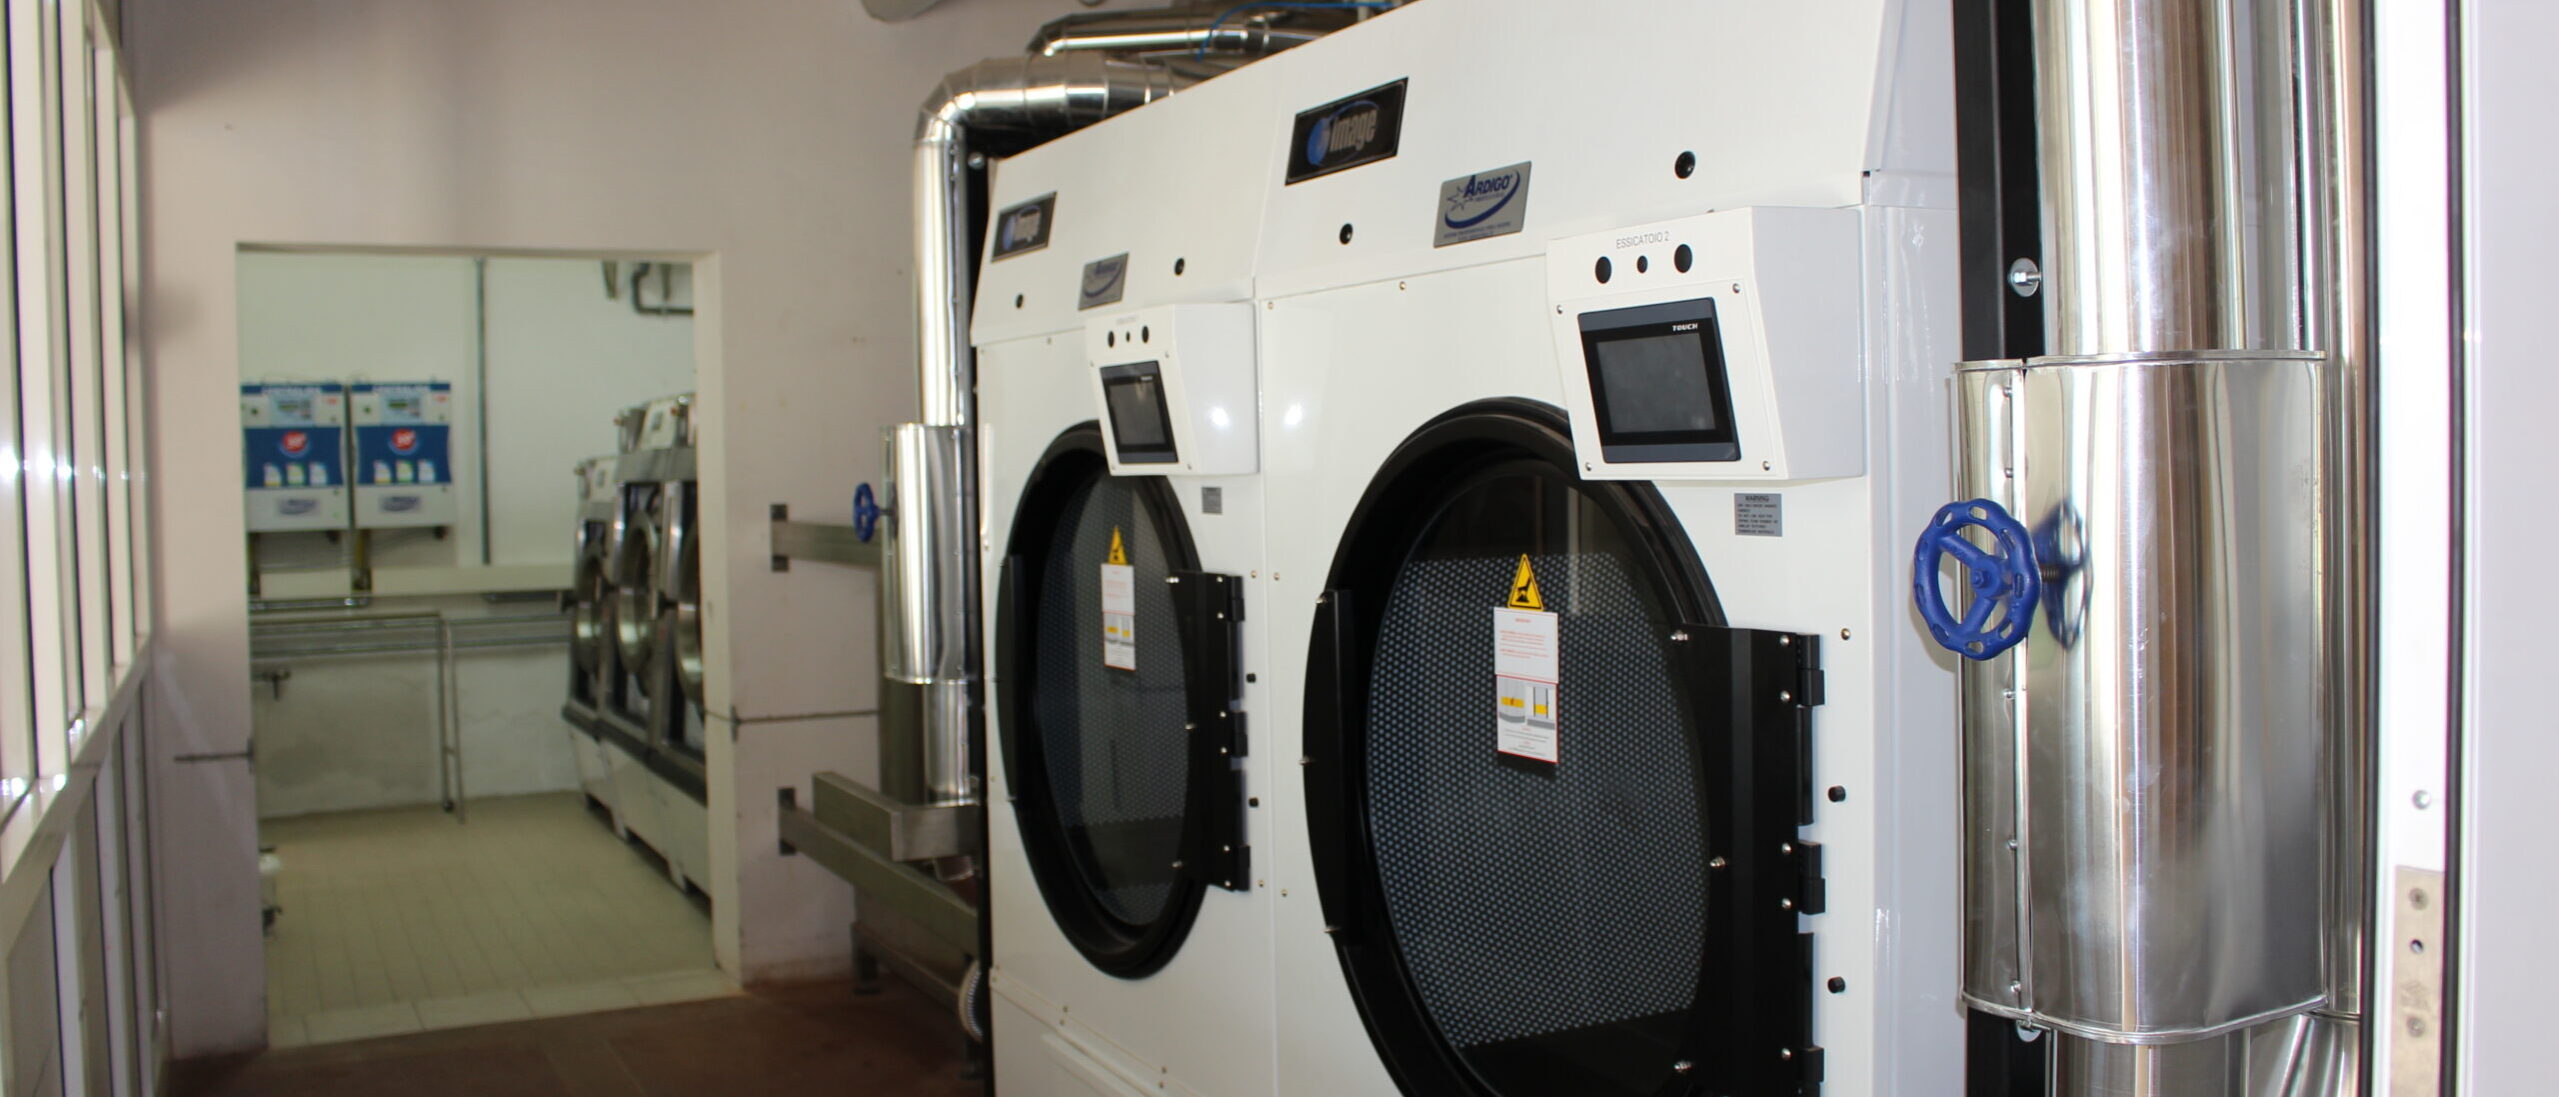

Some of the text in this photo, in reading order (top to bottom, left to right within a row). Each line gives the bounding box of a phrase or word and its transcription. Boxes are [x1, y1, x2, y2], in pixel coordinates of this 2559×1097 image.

[1616, 231, 1670, 249] ESSICATOIO 2
[1672, 323, 1698, 332] TOUCH
